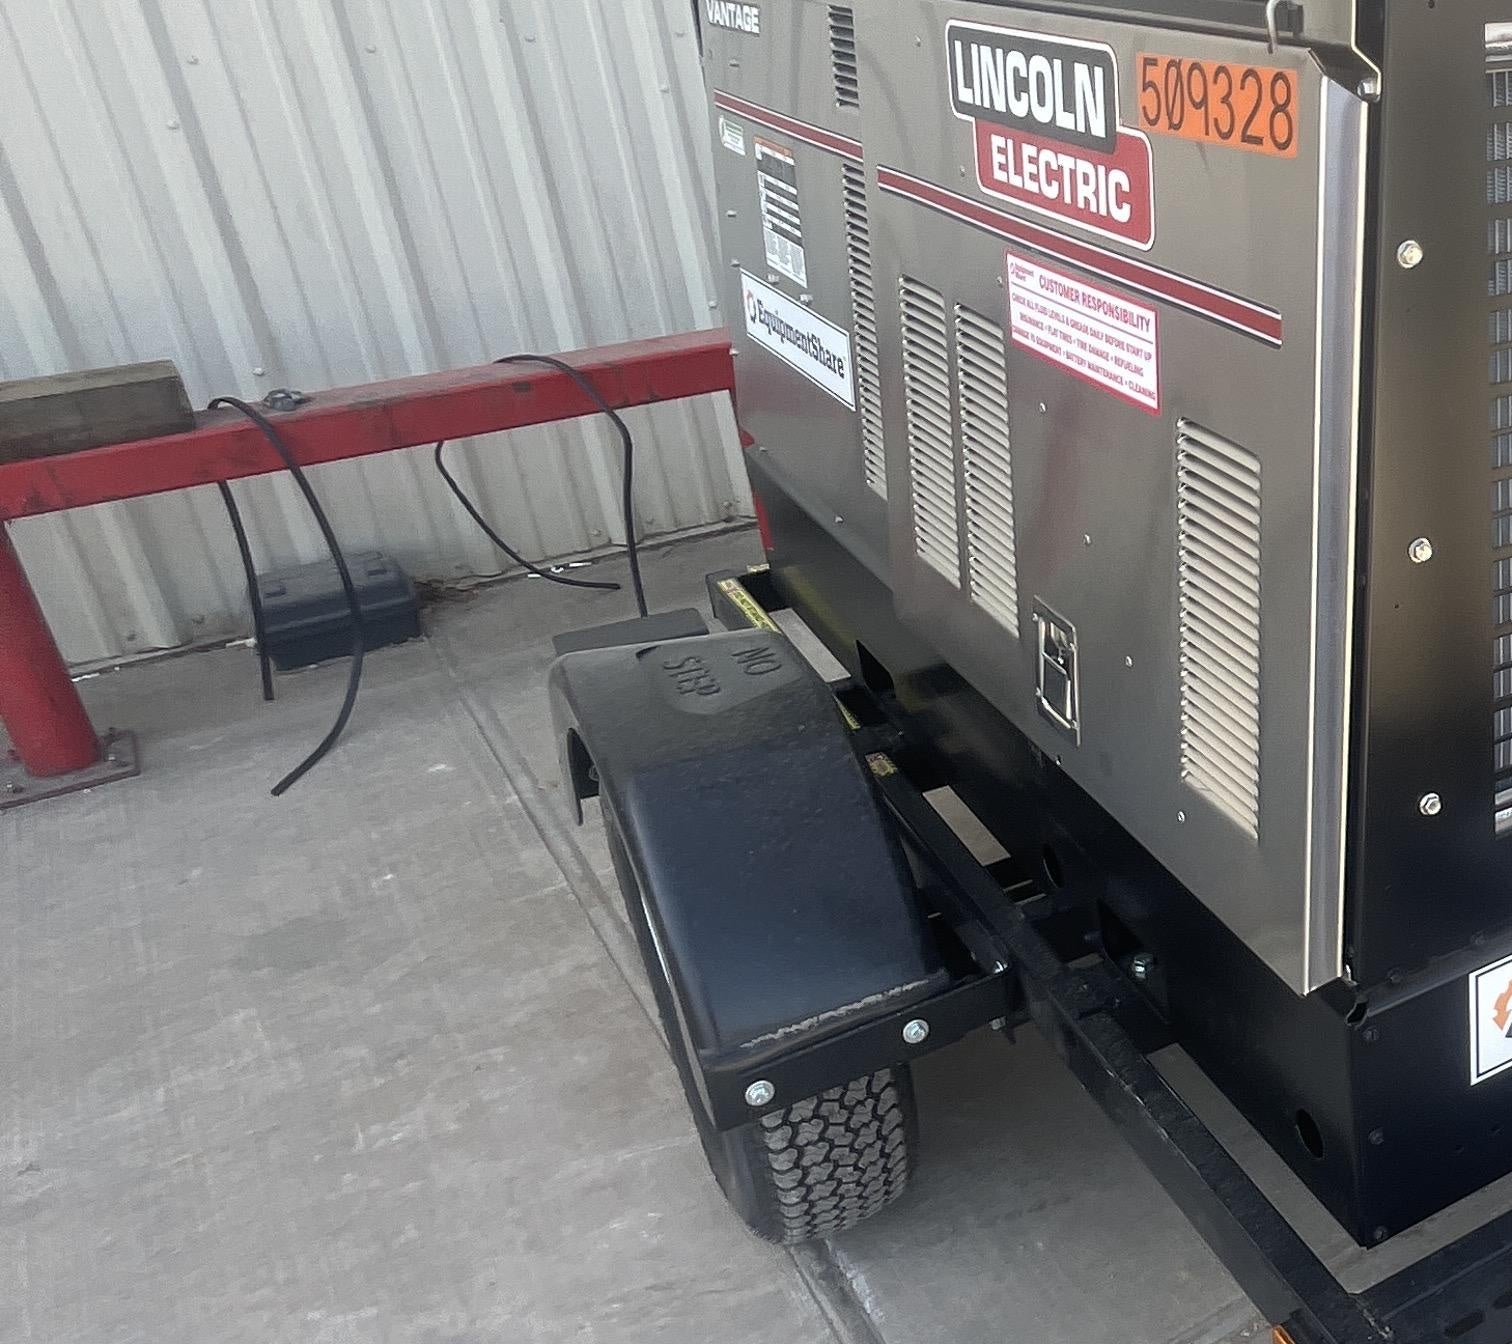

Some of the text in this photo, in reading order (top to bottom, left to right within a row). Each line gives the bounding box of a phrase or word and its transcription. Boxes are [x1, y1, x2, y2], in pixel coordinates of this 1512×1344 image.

[953, 39, 1107, 138] LINCOLN
[1140, 56, 1294, 151] 509328
[990, 133, 1131, 223] ELECTRIC
[757, 299, 845, 379] EquipmentShare
[1039, 274, 1151, 333] CUSTOMER RESPONSIBILITY
